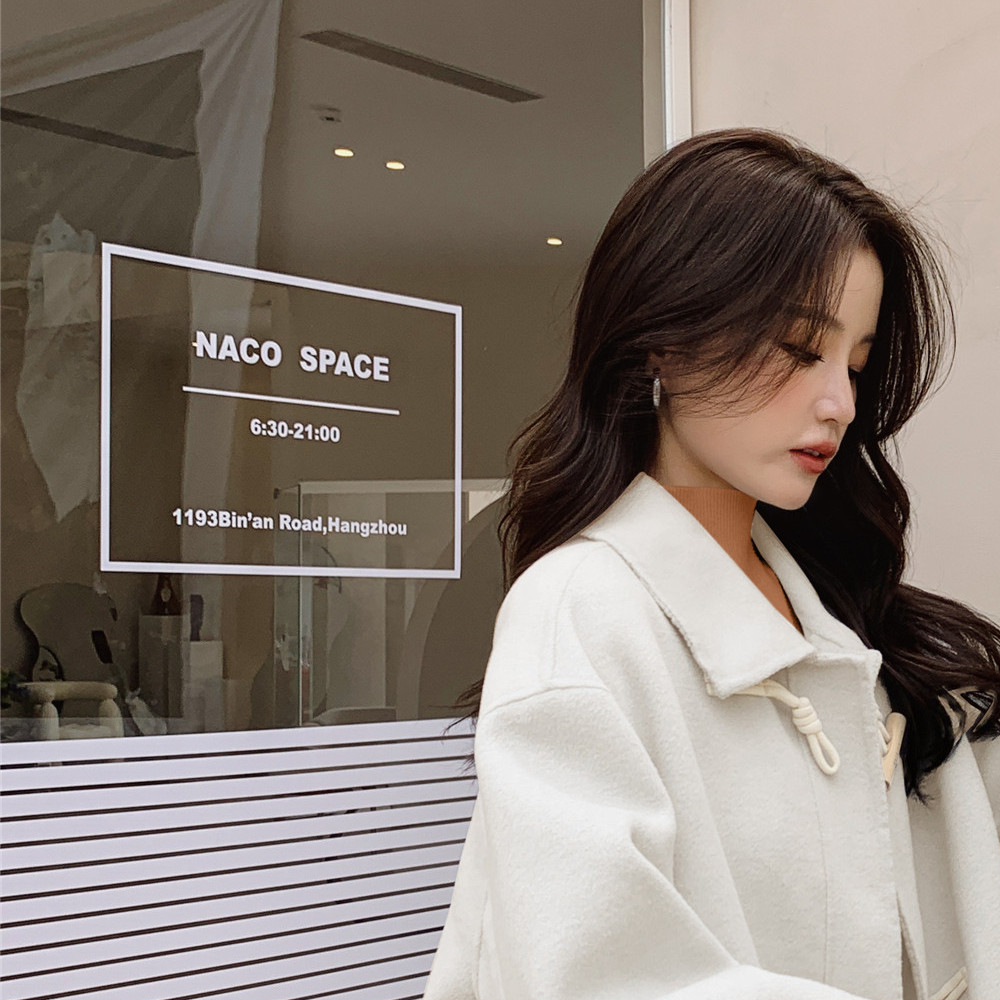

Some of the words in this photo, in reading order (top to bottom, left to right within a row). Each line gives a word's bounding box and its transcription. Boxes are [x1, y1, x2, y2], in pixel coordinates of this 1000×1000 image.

[195, 330, 282, 367] NACO
[299, 346, 390, 382] SPACE
[249, 417, 341, 443] 6:30-21:00
[172, 507, 274, 531] 1193Bin'an
[279, 514, 408, 538] Road,Hangzhou
